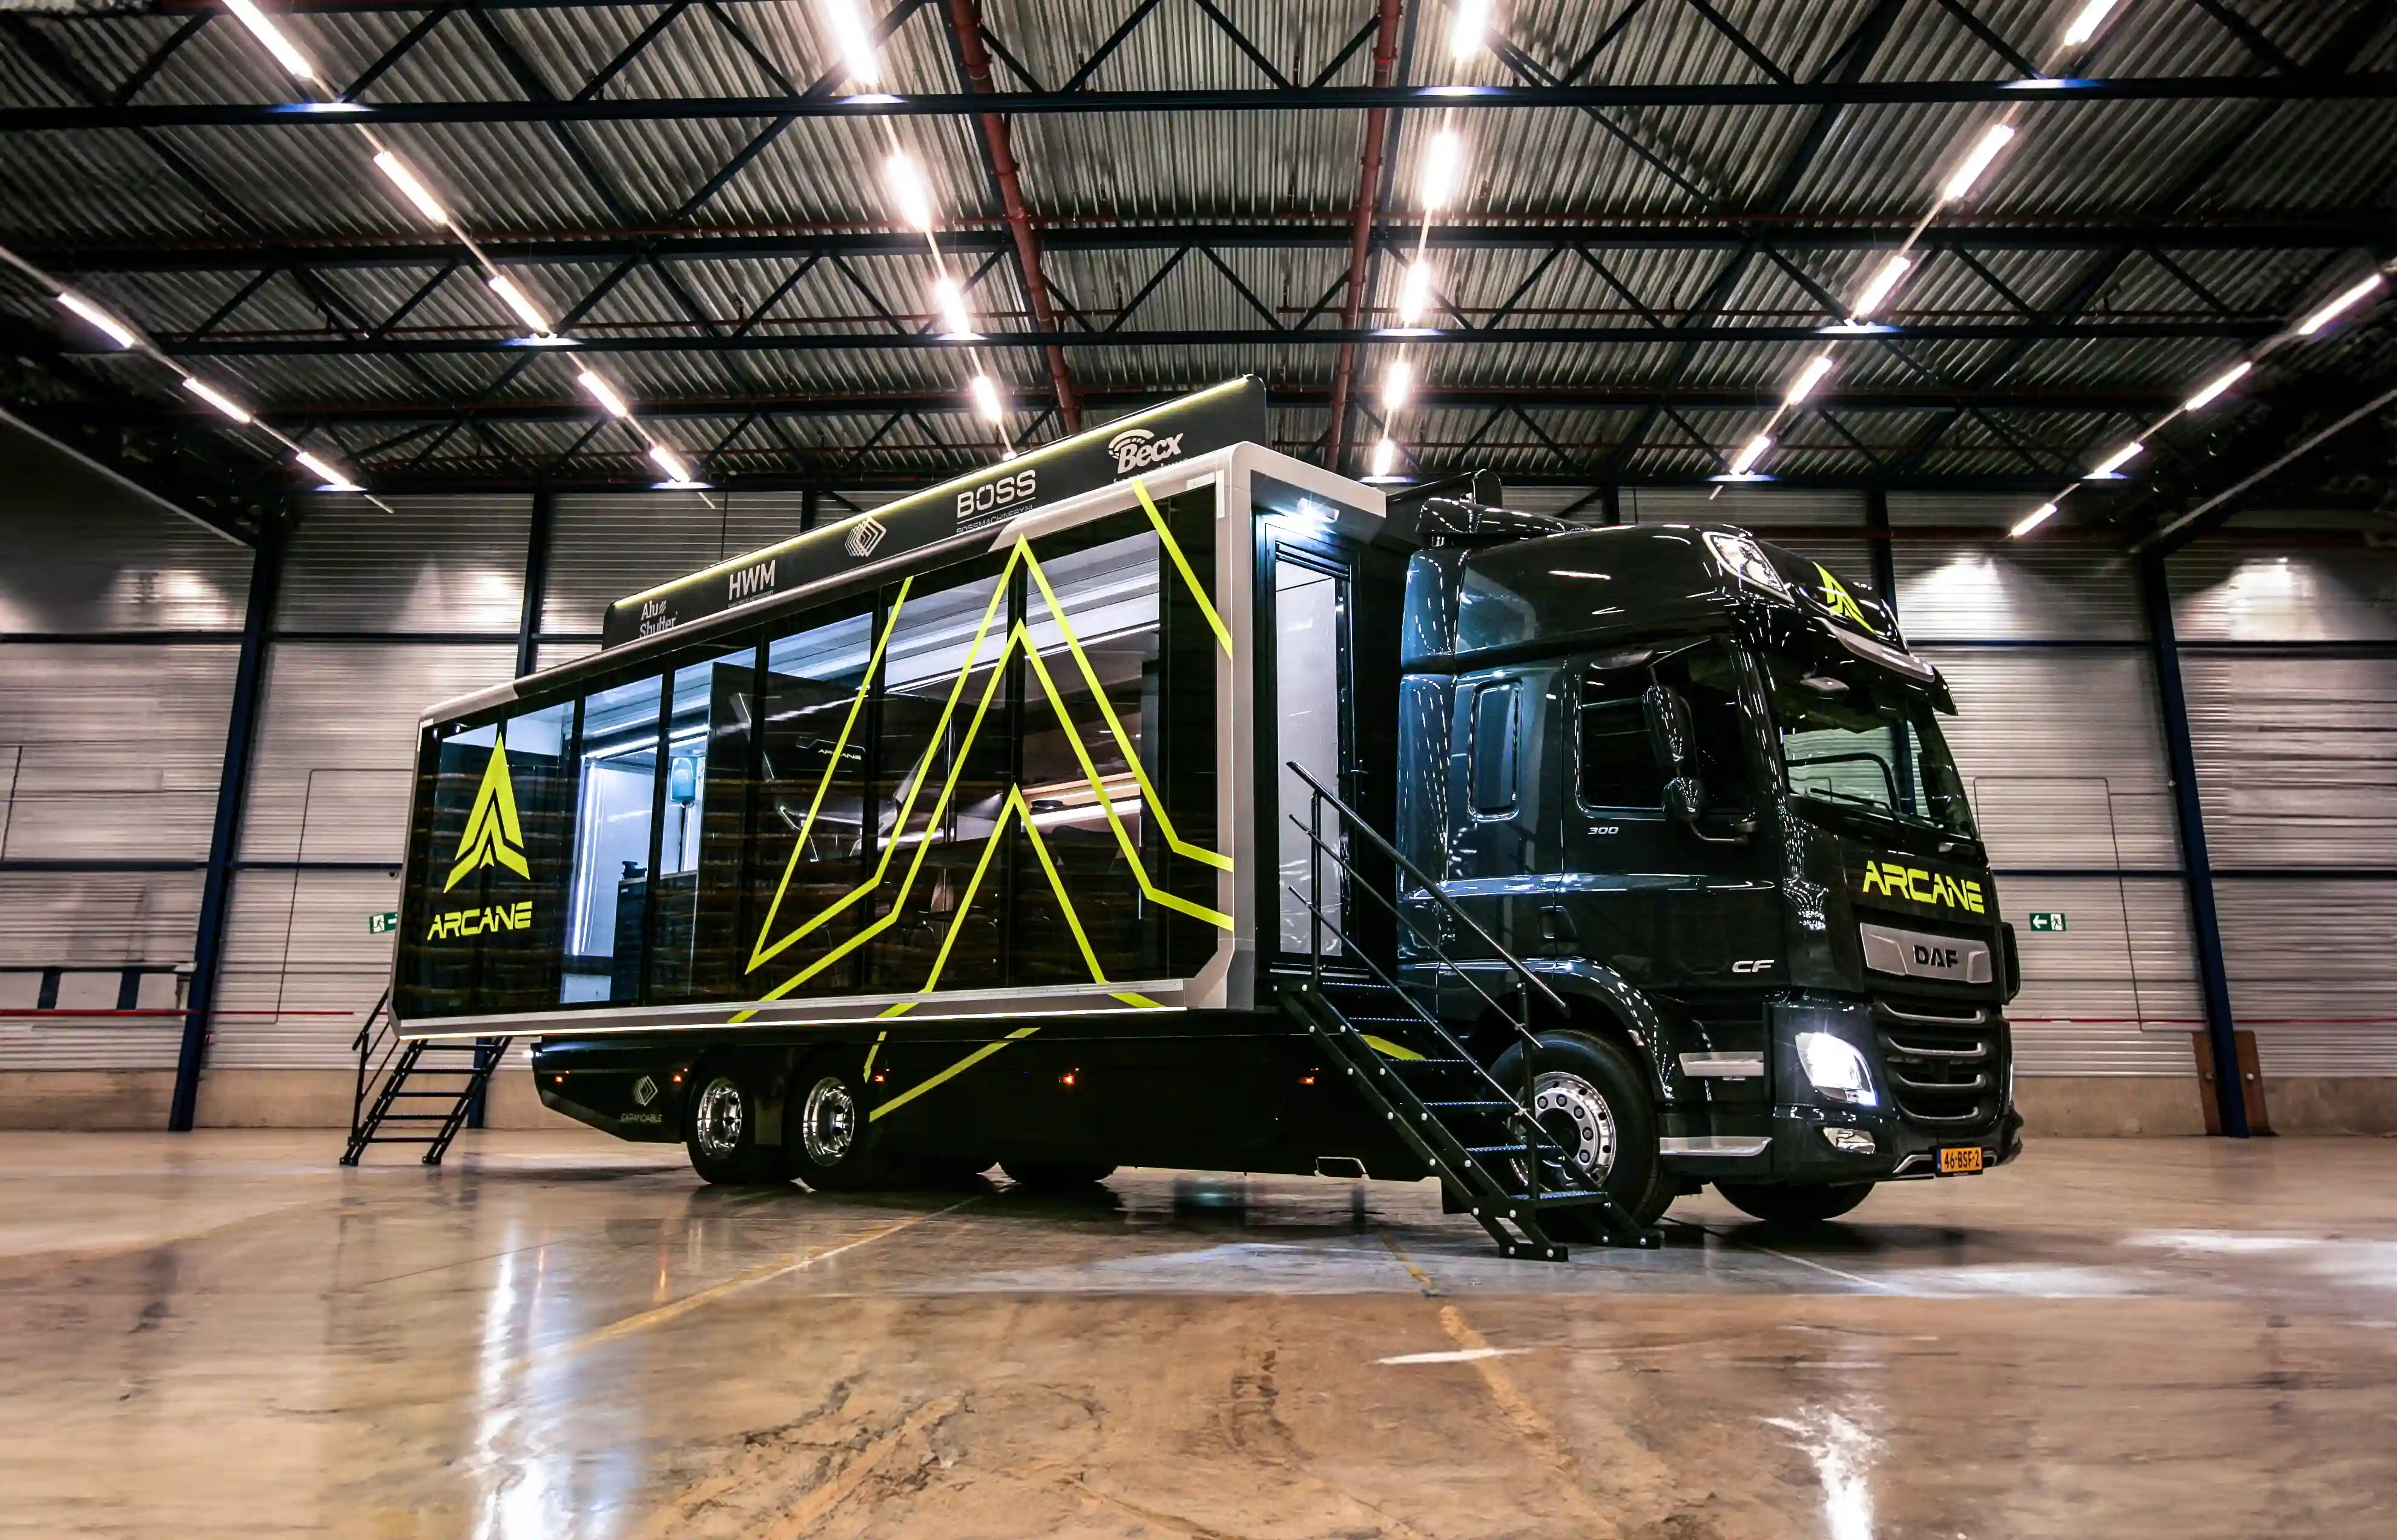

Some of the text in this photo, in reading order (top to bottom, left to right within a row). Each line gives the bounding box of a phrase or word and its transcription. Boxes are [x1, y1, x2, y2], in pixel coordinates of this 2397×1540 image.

[1118, 433, 1184, 474] Becx
[957, 469, 1036, 518] BOSS
[956, 504, 1034, 534] BOSSMACHINERYNL
[728, 559, 776, 601] HWM
[641, 600, 659, 621] Alu
[639, 616, 677, 637] Shutter
[818, 749, 862, 760] ARANE
[1588, 826, 1619, 835] 300
[1862, 860, 1985, 914] ARCANE
[427, 901, 532, 942] ARCANE
[1732, 959, 1775, 973] CF
[1913, 944, 1958, 969] DAF
